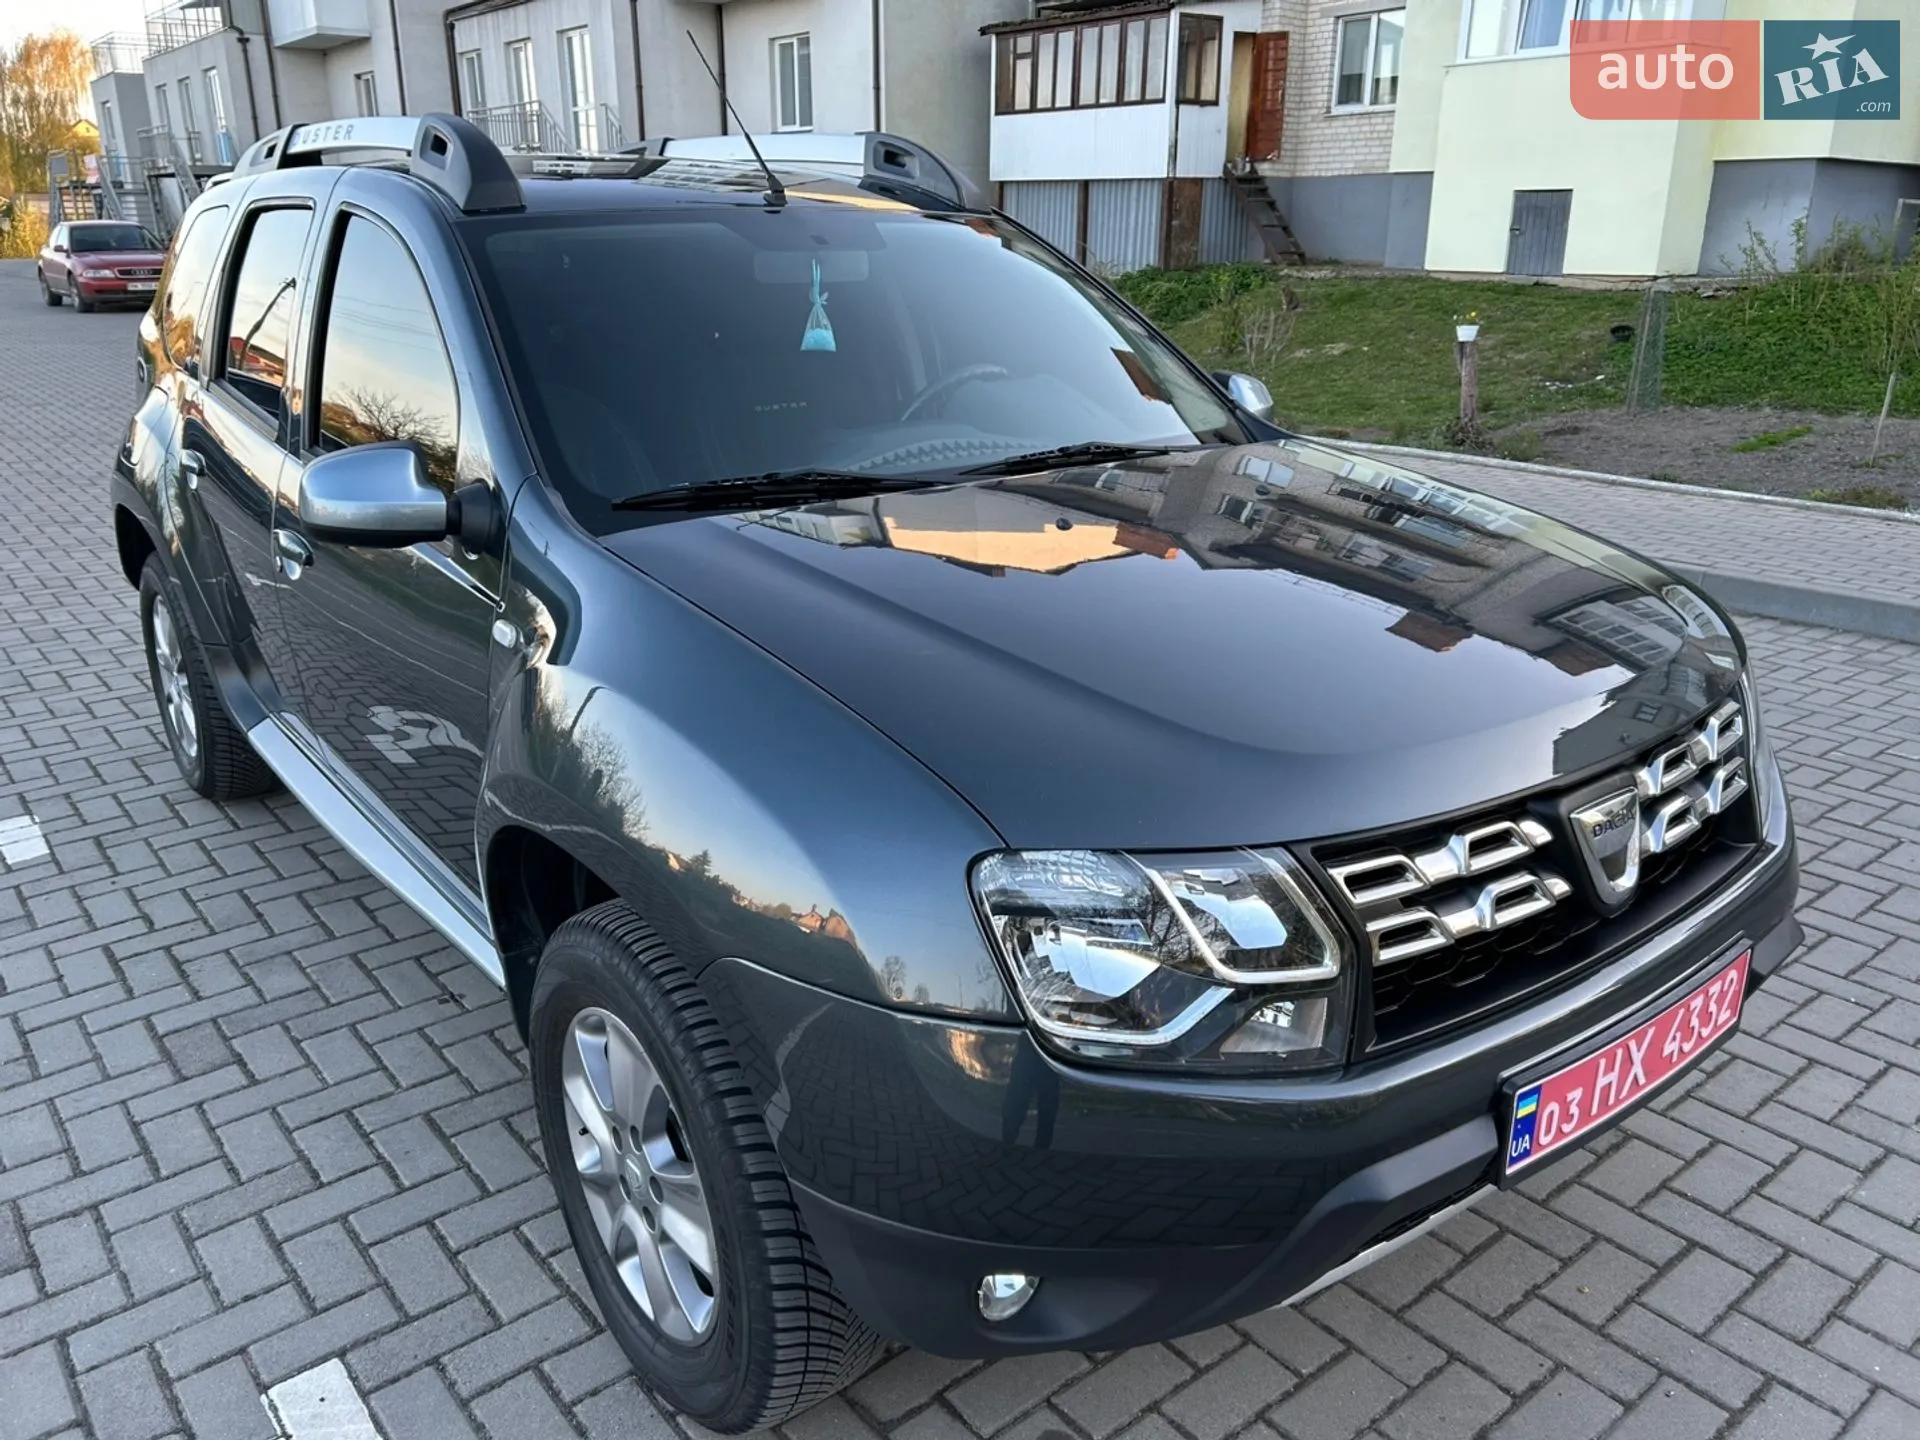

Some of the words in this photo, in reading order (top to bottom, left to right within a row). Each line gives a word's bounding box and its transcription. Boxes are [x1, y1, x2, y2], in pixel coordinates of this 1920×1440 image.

[1591, 805, 1636, 839] DACIA
[1537, 1086, 1584, 1147] 03
[1590, 1025, 1657, 1117] HX
[1661, 968, 1739, 1063] 4332
[1511, 1133, 1531, 1158] UA
